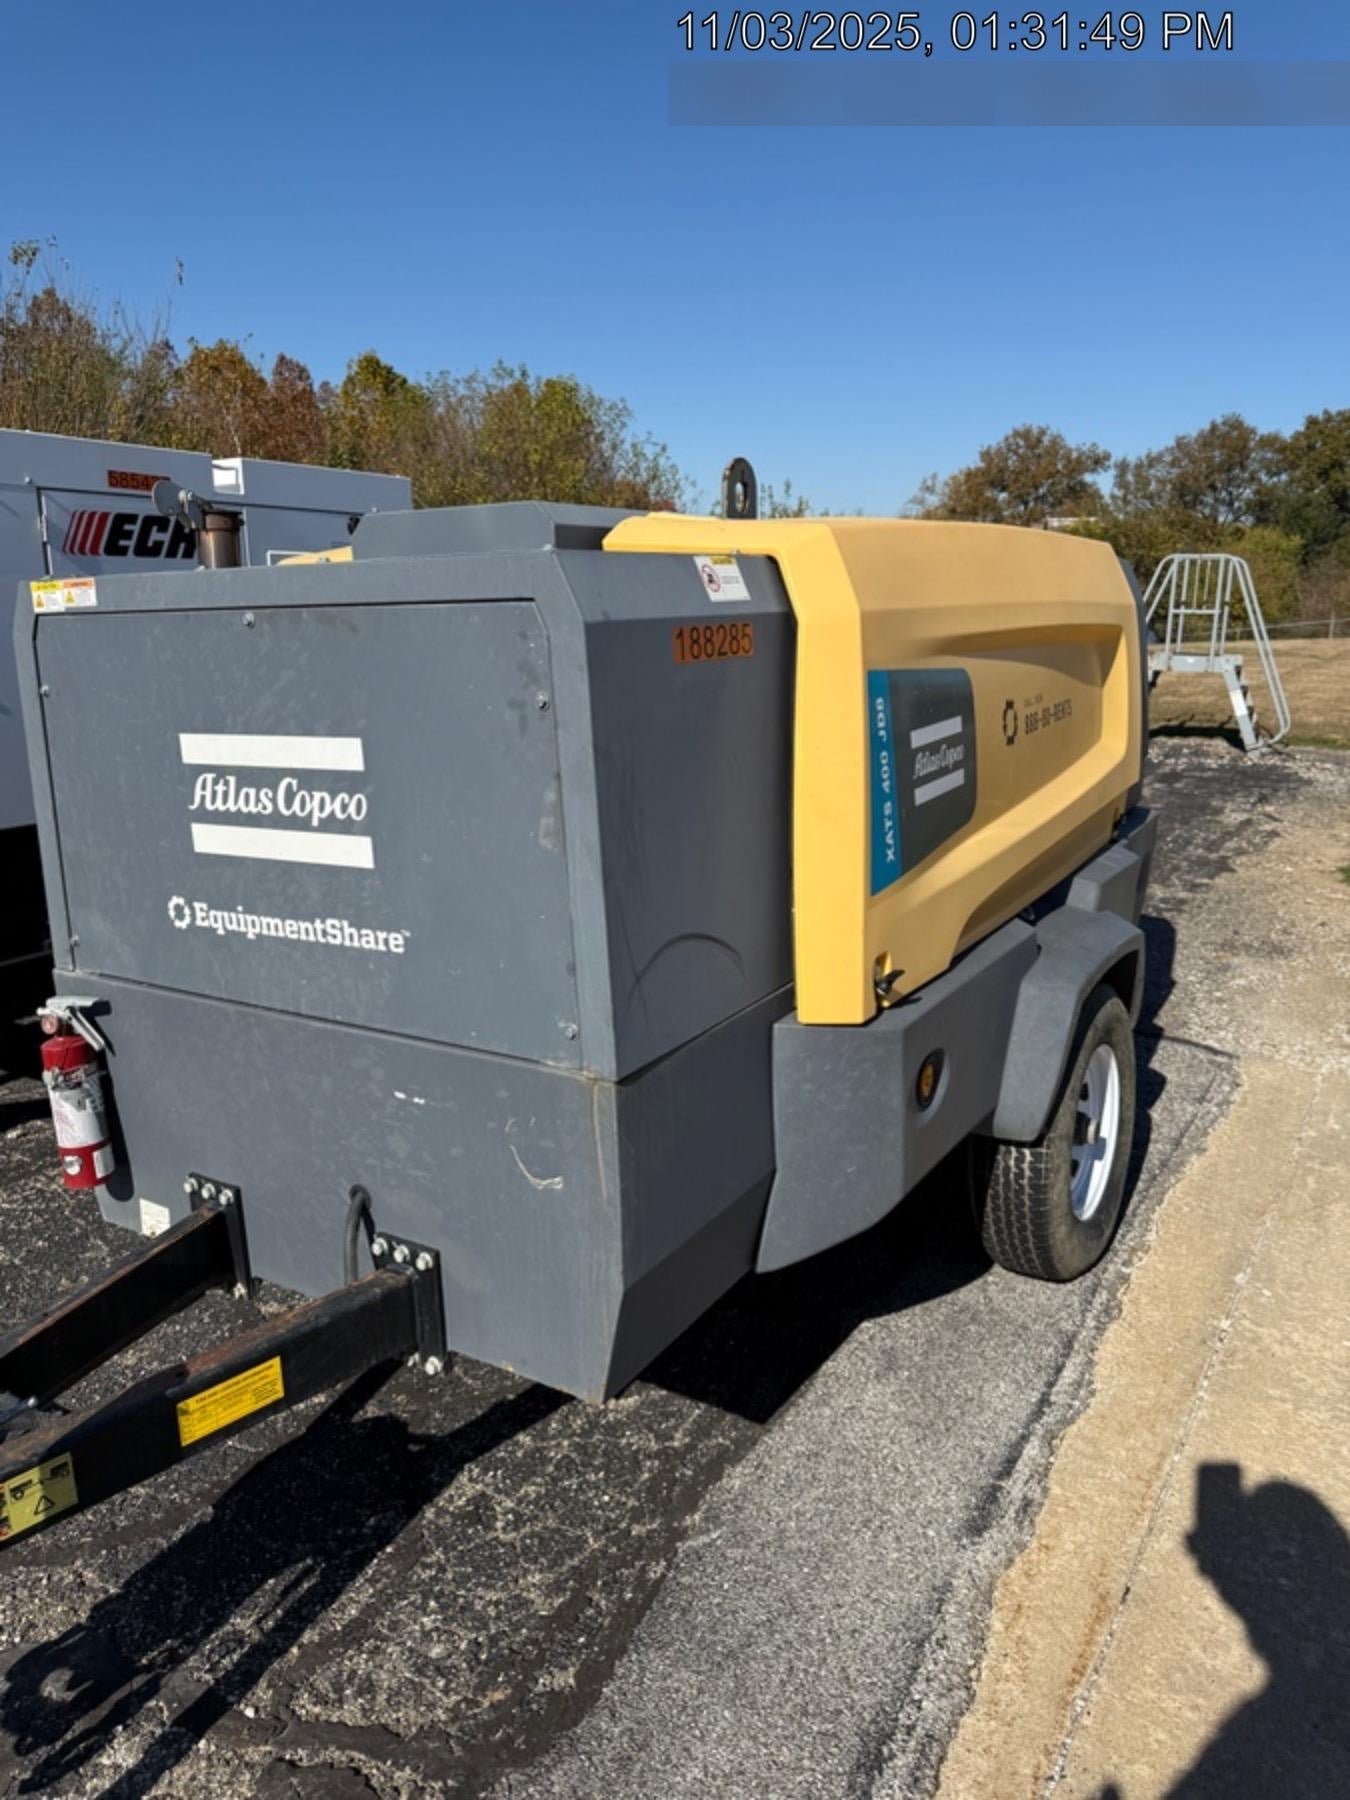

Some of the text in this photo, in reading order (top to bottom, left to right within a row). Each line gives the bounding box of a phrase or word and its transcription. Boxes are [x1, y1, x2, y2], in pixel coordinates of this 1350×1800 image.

[674, 622, 754, 661] 188285
[879, 751, 891, 794] 400
[882, 801, 896, 864] XATS
